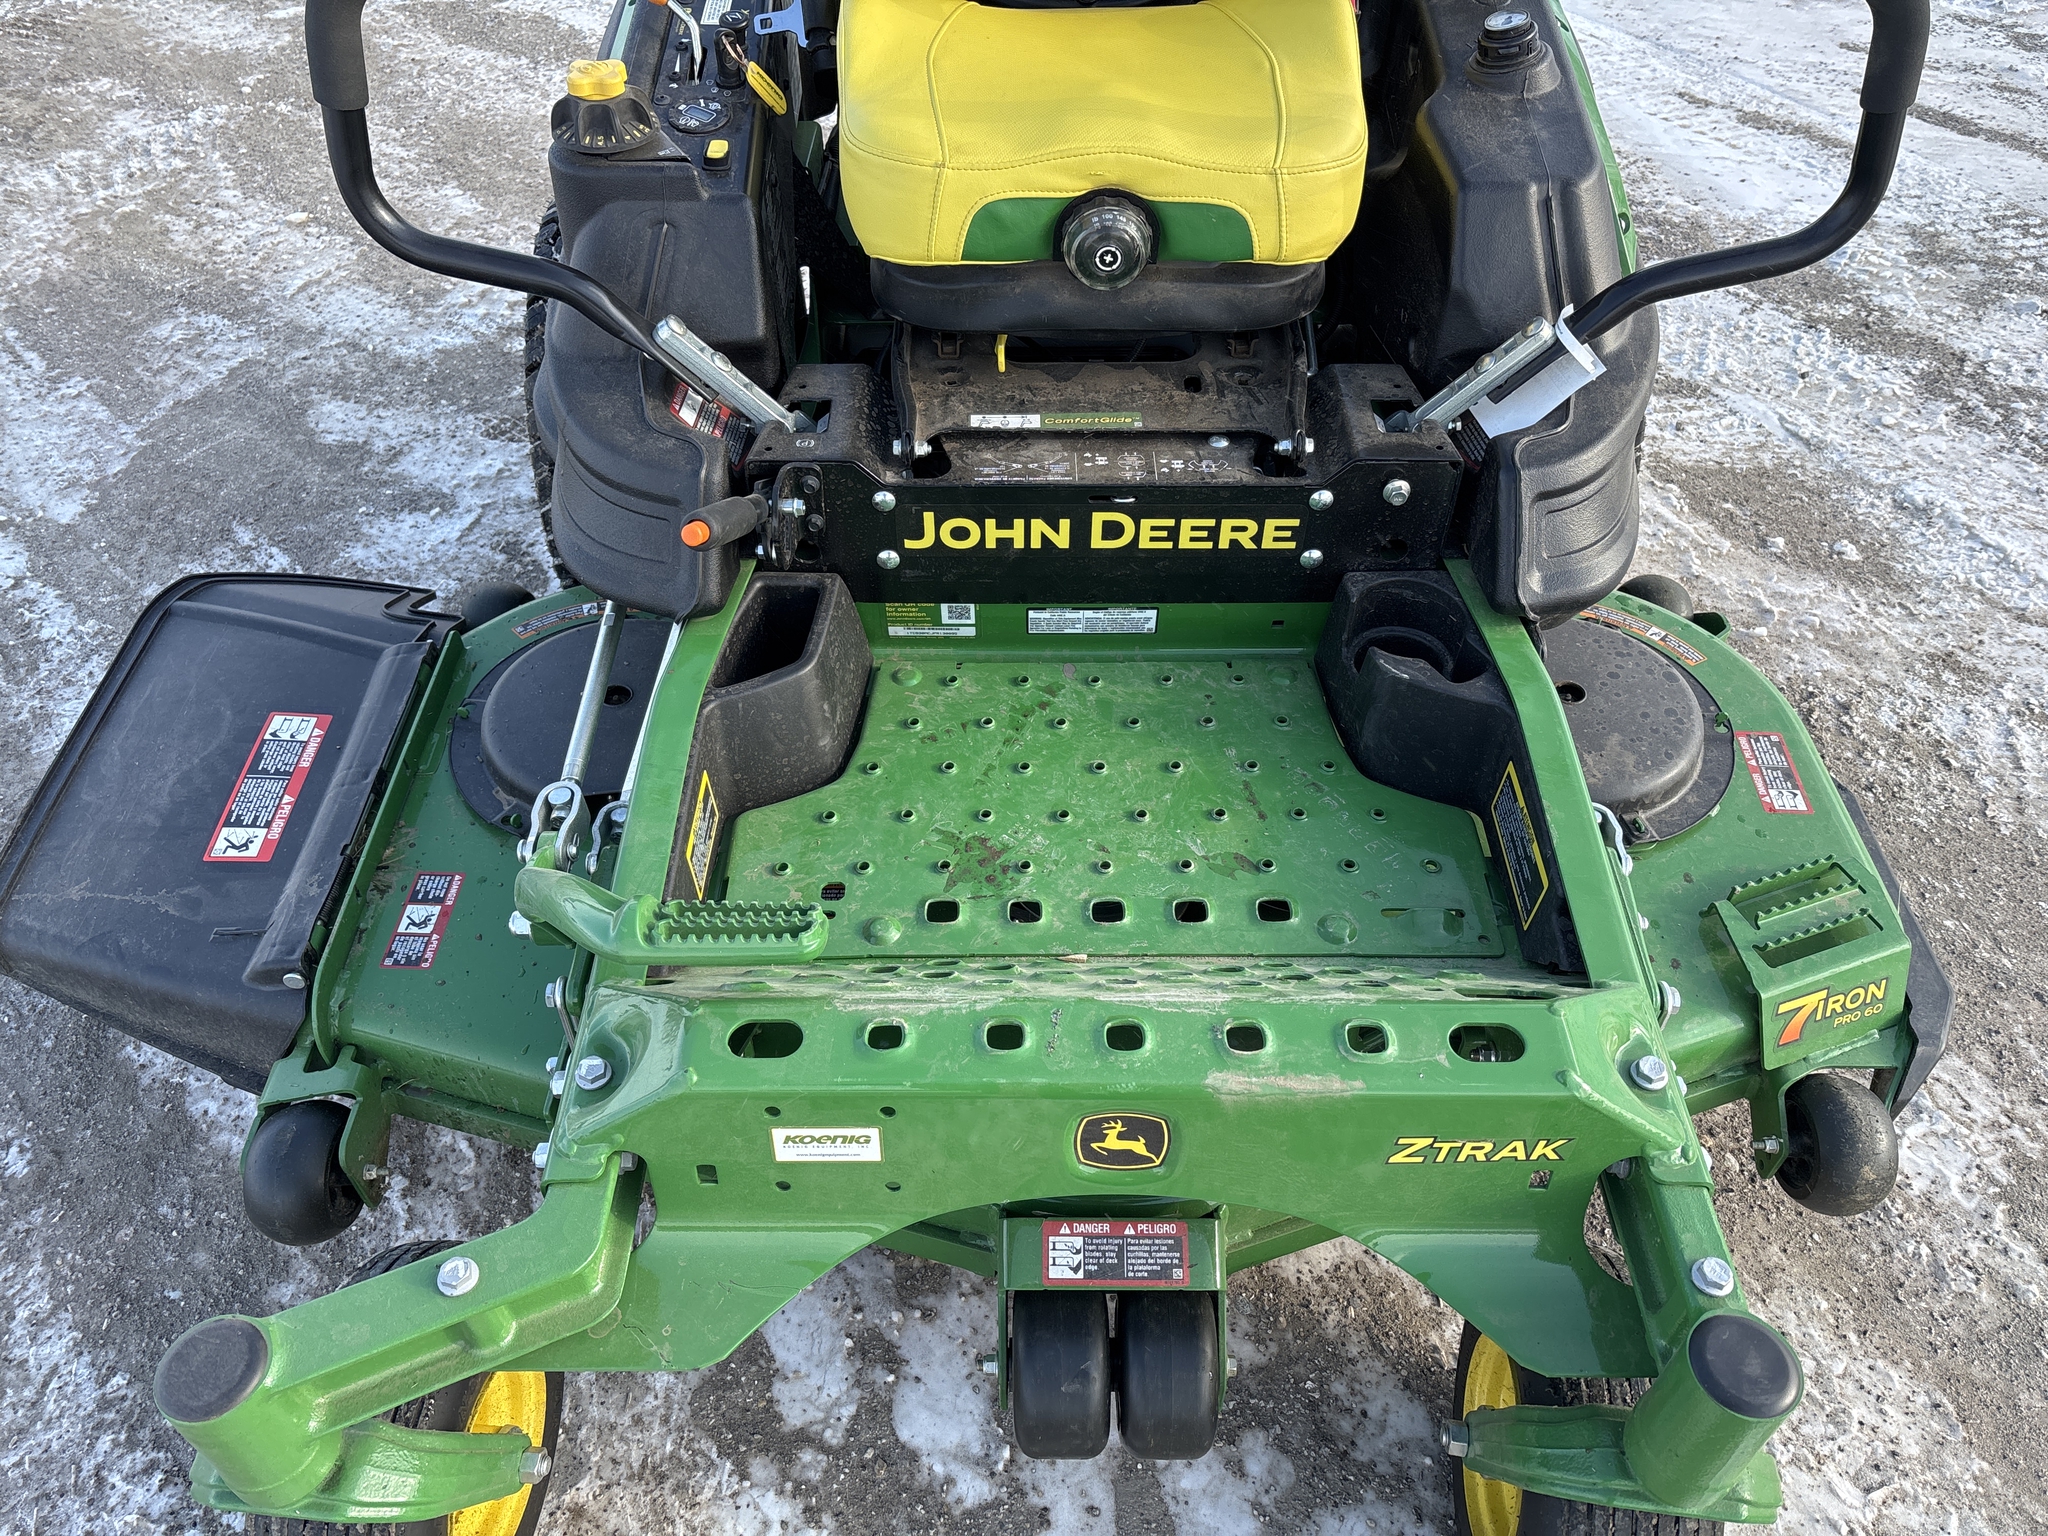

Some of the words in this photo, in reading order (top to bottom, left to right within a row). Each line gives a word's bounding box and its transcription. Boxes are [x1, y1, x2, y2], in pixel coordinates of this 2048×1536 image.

[903, 511, 1071, 550] JOHN
[1090, 511, 1301, 549] DEERE
[298, 736, 321, 768] DANGER
[1752, 773, 1768, 795] DANGER
[267, 804, 292, 840] PELIGRO
[445, 881, 461, 906] DANGER
[1834, 1010, 1861, 1028] PRO
[1864, 1003, 1883, 1017] 60
[1385, 1136, 1574, 1164] ZTRAK
[1073, 1223, 1110, 1234] DANGER
[1137, 1223, 1177, 1234] PELIGRO
